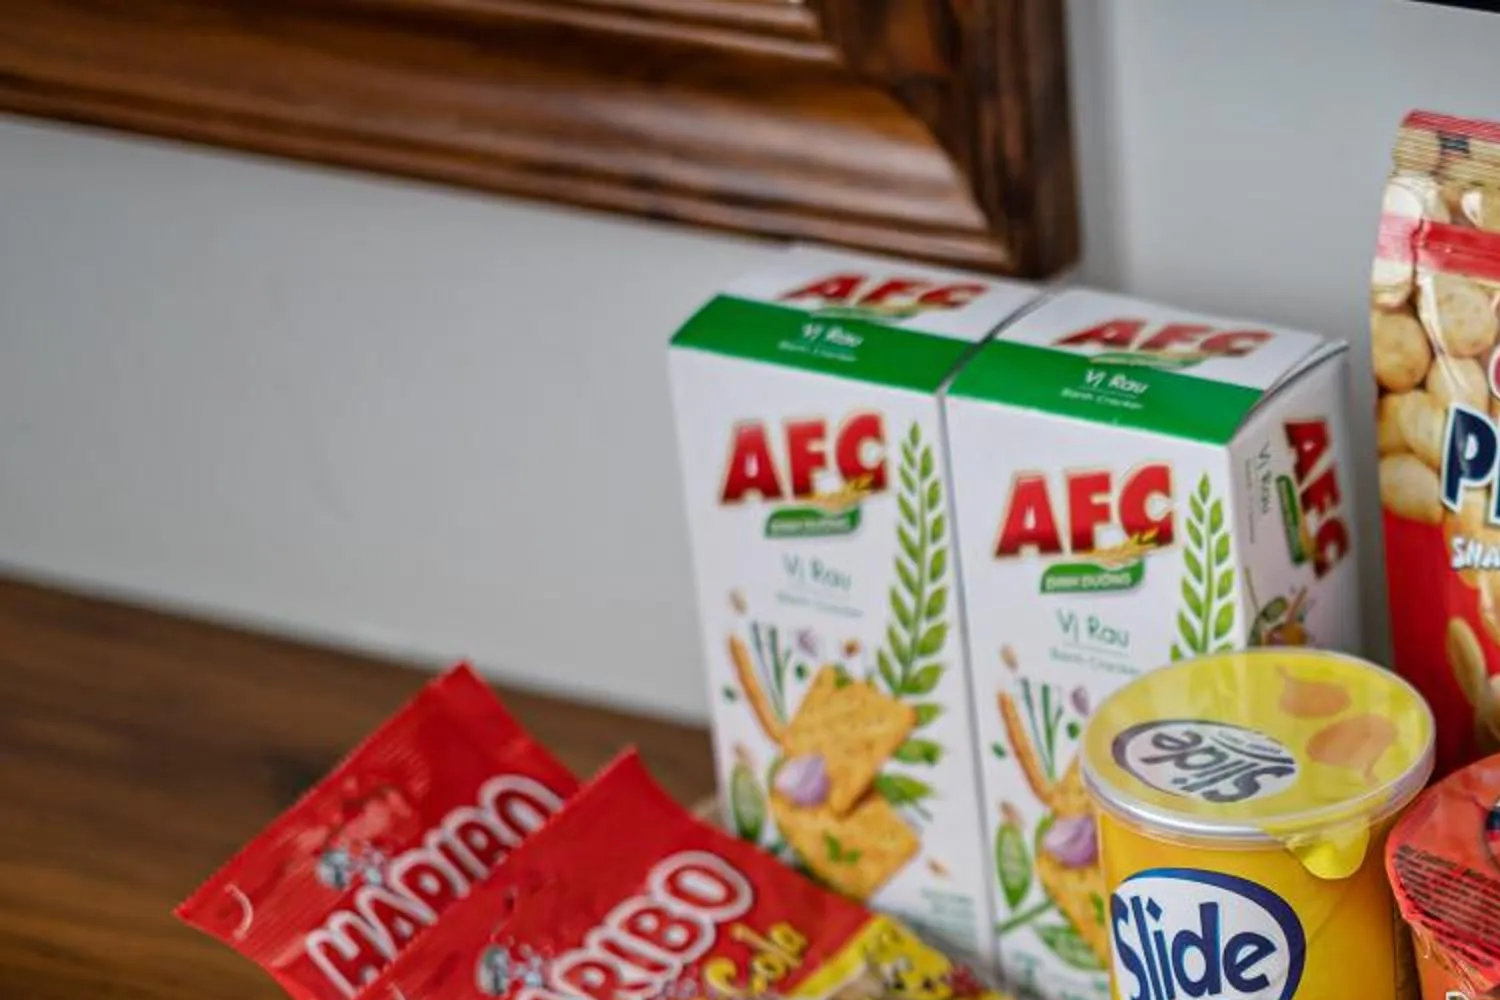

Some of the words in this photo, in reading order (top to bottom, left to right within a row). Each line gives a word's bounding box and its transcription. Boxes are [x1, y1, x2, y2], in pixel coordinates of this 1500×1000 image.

[778, 273, 992, 310] AFC
[1054, 319, 1277, 357] AFC
[719, 411, 889, 506] AFC
[993, 461, 1175, 559] AFC
[1087, 615, 1130, 648] Rau
